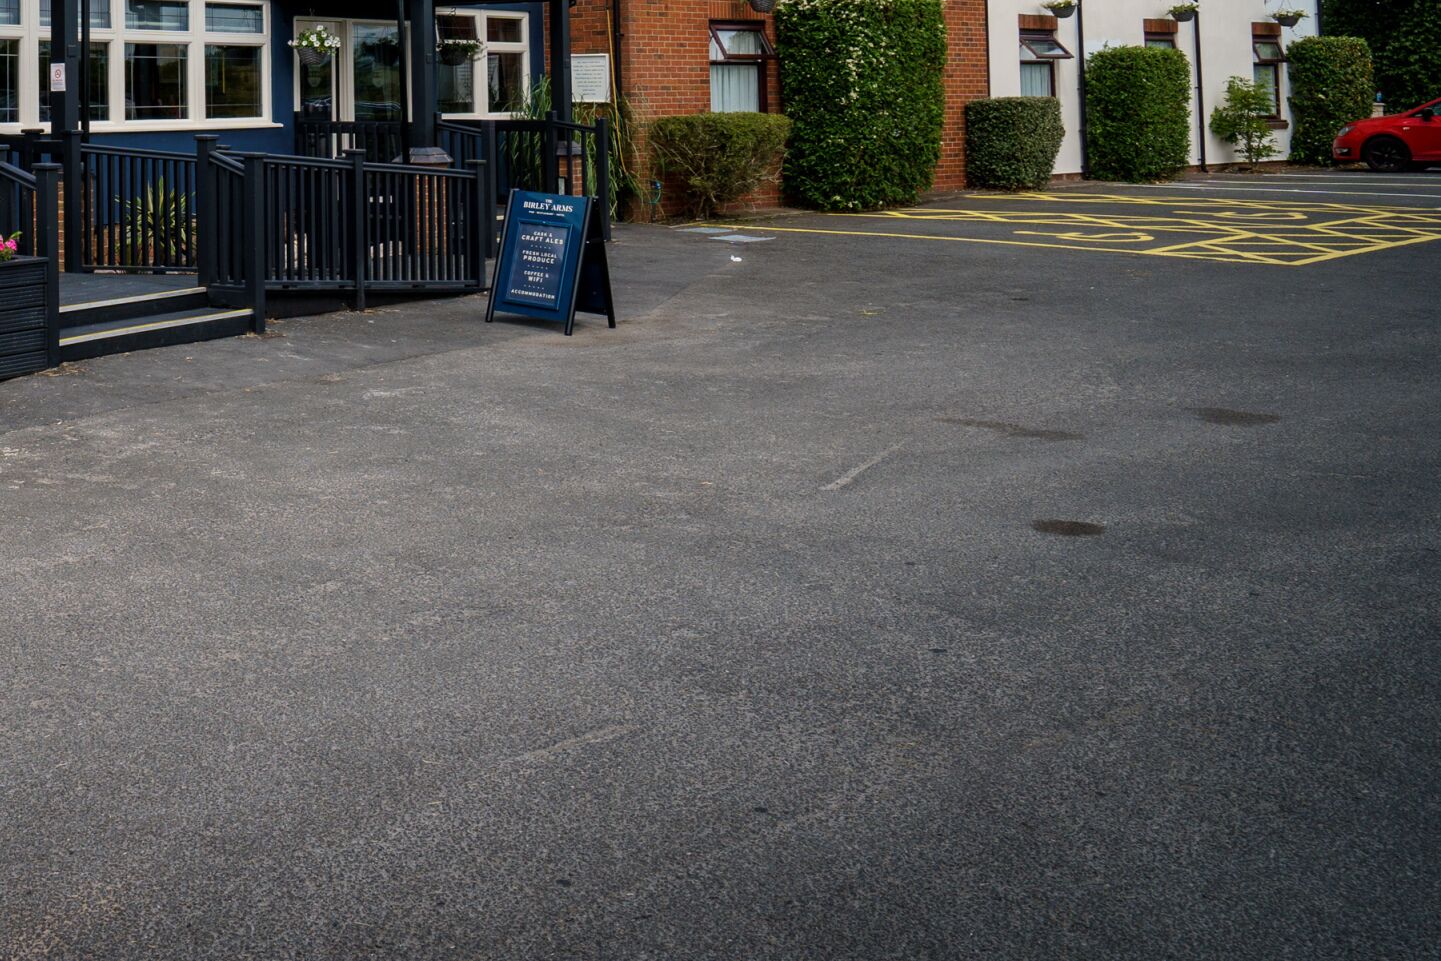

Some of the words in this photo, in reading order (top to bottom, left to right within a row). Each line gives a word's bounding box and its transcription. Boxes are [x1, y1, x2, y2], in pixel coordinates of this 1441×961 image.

[523, 201, 551, 210] BIRLEY
[551, 204, 574, 213] ARMS
[521, 234, 543, 242] CRAFT
[523, 255, 555, 264] PRODUCE
[511, 288, 555, 299] ACCOMMODATION
